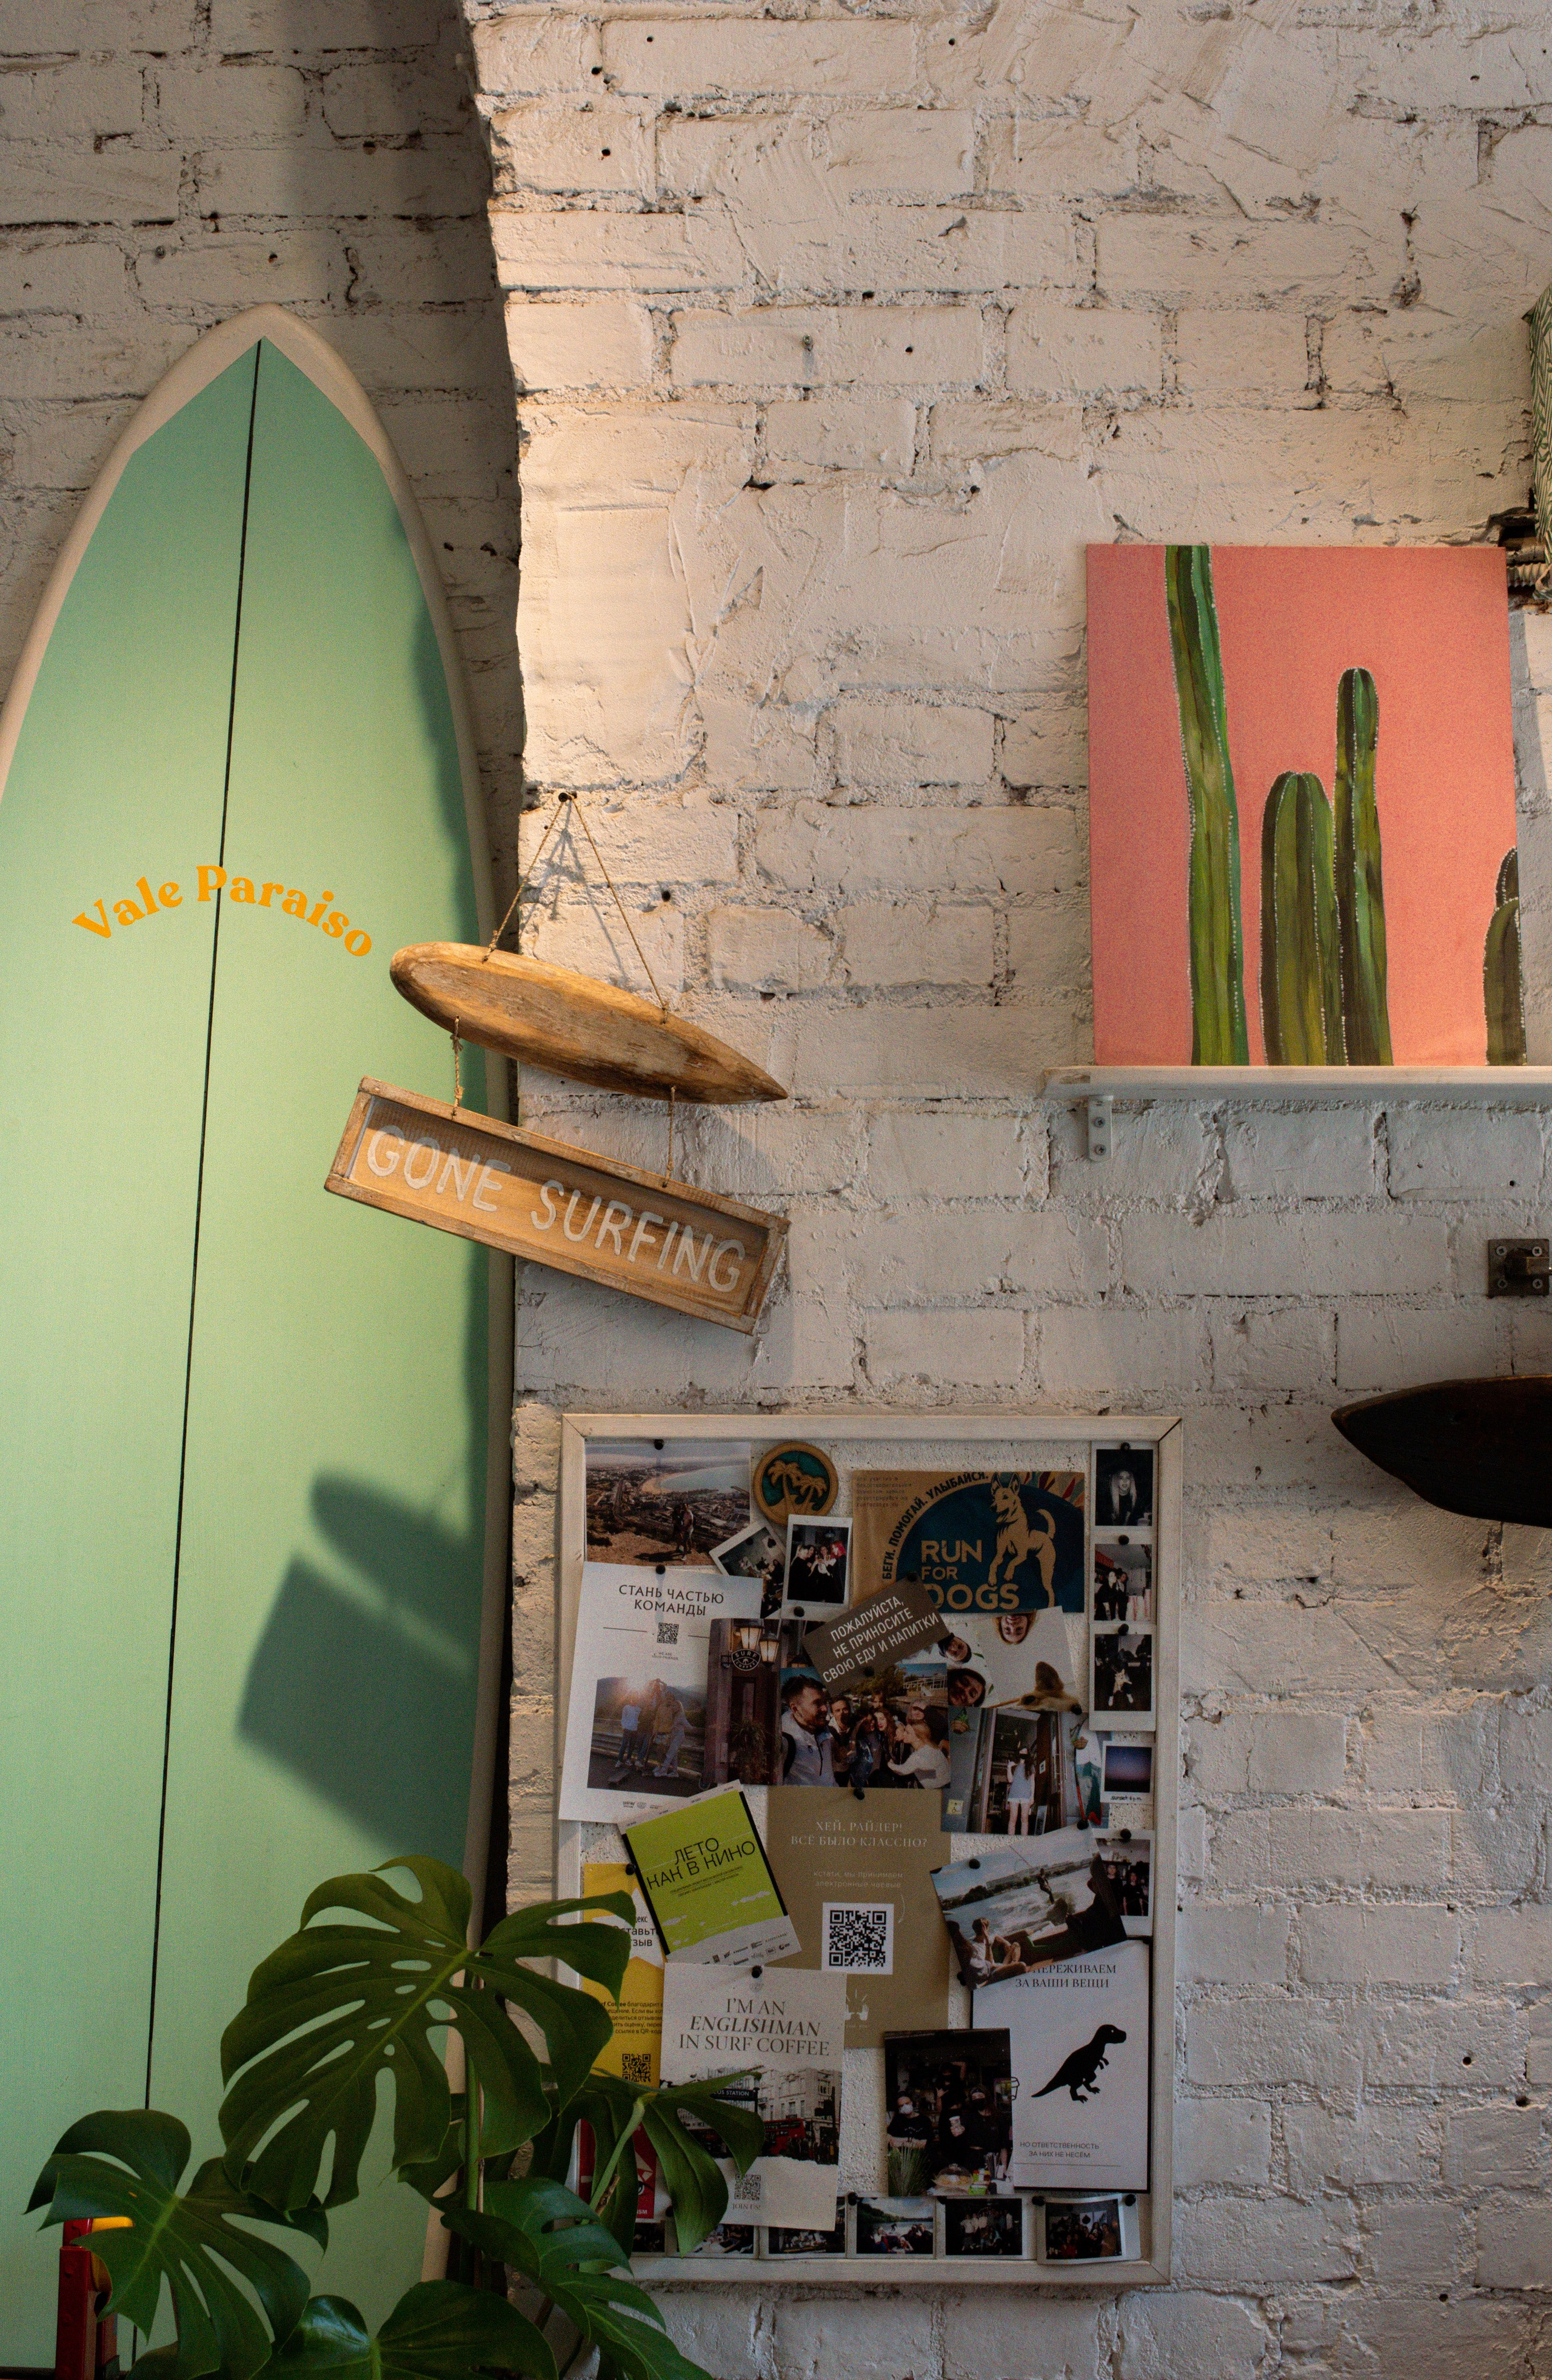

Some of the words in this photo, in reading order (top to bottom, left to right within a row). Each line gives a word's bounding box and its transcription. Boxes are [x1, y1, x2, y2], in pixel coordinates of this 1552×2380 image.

[71, 876, 183, 938] Vale
[196, 865, 372, 957] Paraiso
[366, 1124, 512, 1212] GONE
[530, 1179, 746, 1292] SURFING
[882, 1549, 896, 1580] БЕГИ.
[889, 1496, 928, 1547] ПОМОГАЙ.
[925, 1471, 989, 1500] УЛЫБАЙСЯ.
[921, 1539, 982, 1563] RUN
[921, 1566, 958, 1581] FOR
[618, 1584, 662, 1598] СТАНЬ
[667, 1588, 724, 1604] ЧАСТЬЮ
[923, 1583, 1020, 1611] DOGS
[634, 1599, 706, 1617] КОМАНДЫ
[831, 1596, 904, 1642] ПОЖАЛУЙСТА,
[832, 1643, 849, 1659] НЕ
[849, 1608, 914, 1650] ПРИНОСИТЕ
[822, 1658, 855, 1683] СВОЮ
[855, 1645, 877, 1665] ЕДУ
[877, 1640, 889, 1653] И
[888, 1612, 940, 1647] НАПИТКИ
[849, 1820, 903, 1832] РАЙДЕР!
[674, 1837, 719, 1865] ЛЕТО
[791, 1834, 815, 1845] ВСЁ
[819, 1836, 856, 1846] БЫЛО
[860, 1837, 928, 1848] КЛАССНО?
[646, 1866, 683, 1890] КАК
[686, 1860, 700, 1876] В
[703, 1840, 755, 1870] КИНО
[1015, 1978, 1030, 1988] ЗА
[1032, 1979, 1069, 1988] ВАШИ
[1072, 1979, 1109, 1989] ВЕЩИ
[726, 1998, 754, 2014] I'M
[758, 2000, 786, 2016] AN
[689, 2015, 821, 2037] ENGLISHMAN
[679, 2034, 700, 2049] IN
[704, 2034, 753, 2051] SURF
[756, 2037, 830, 2056] COFFEE
[1031, 2141, 1100, 2150] ОТВЕТСТВЕННОСТЬ
